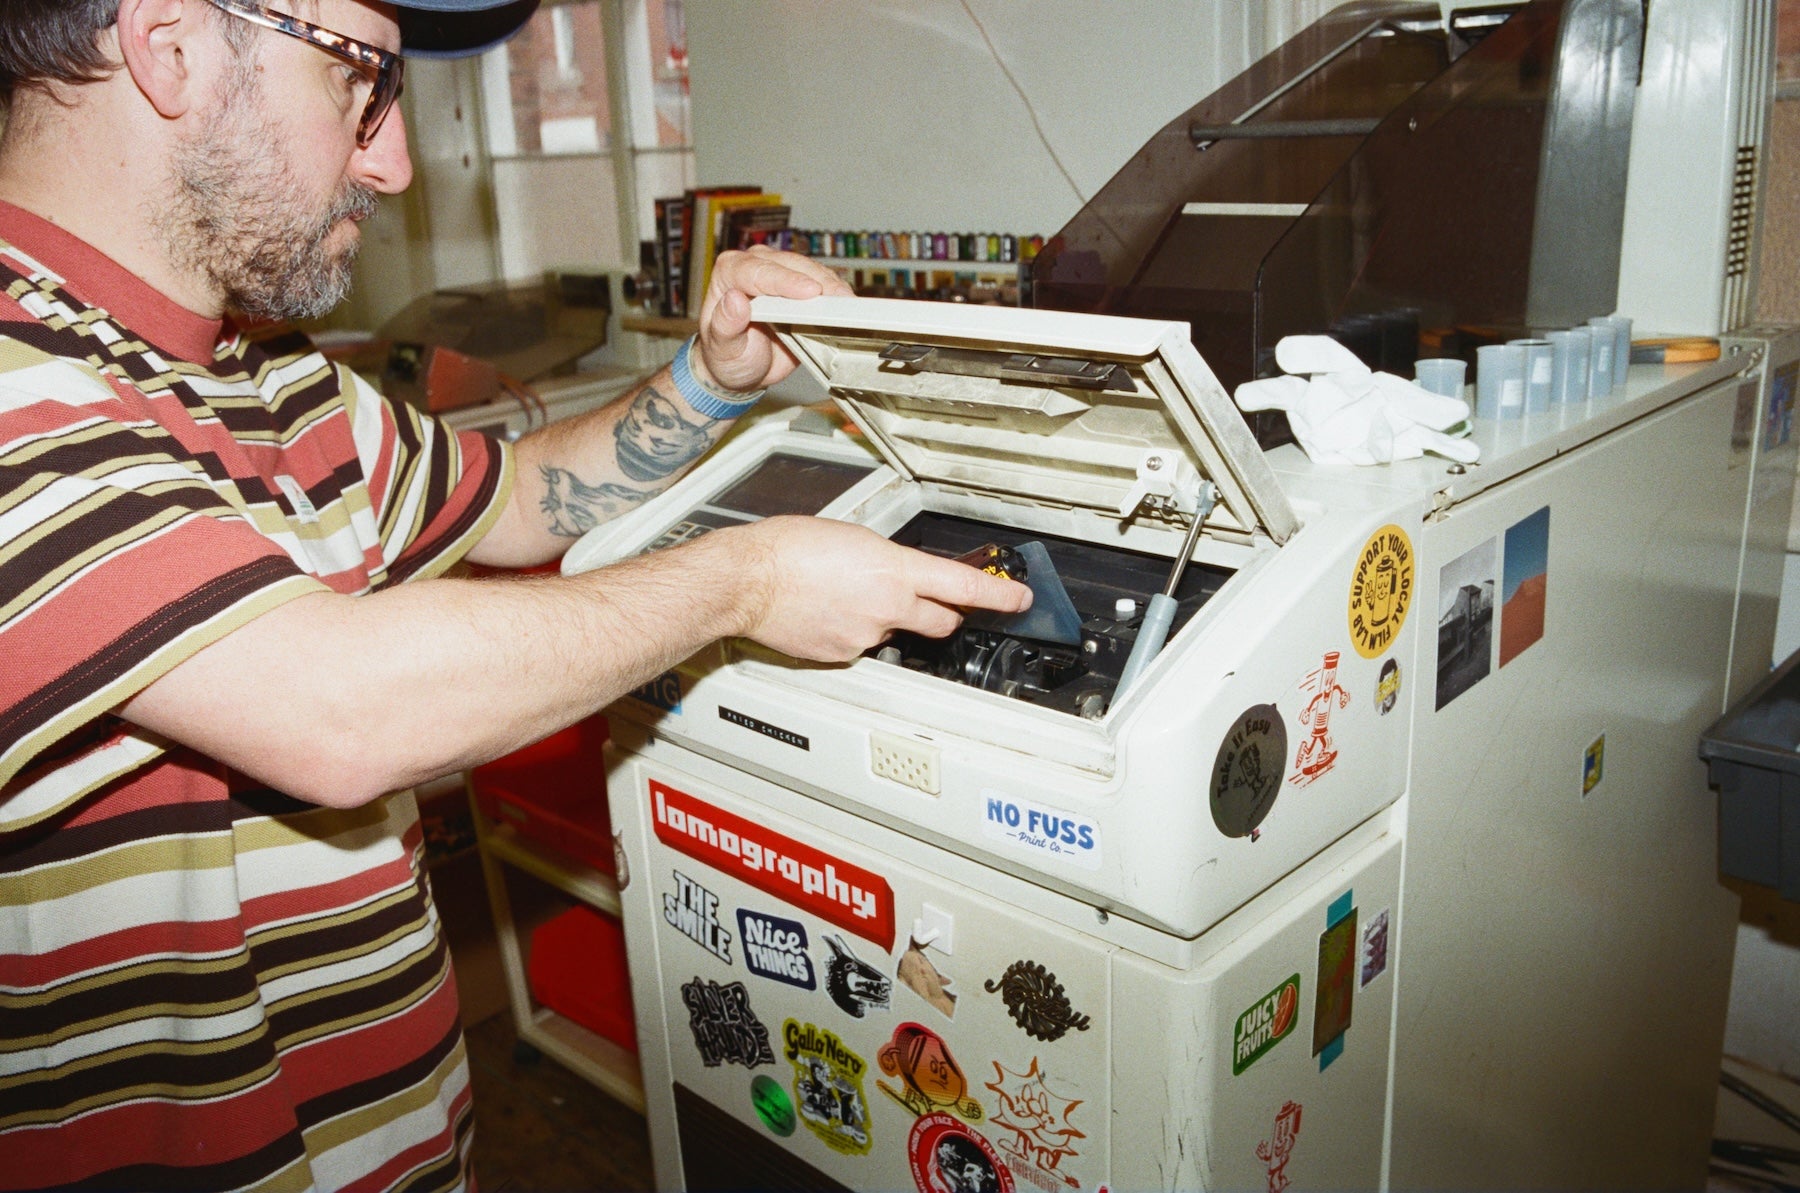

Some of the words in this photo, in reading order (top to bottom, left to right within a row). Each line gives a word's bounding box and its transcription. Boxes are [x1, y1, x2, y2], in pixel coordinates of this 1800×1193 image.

[1352, 534, 1385, 610] SUPPORT
[1388, 533, 1408, 566] YOUR
[1392, 566, 1410, 624] LOCAL
[1353, 614, 1369, 646] LAB
[1368, 624, 1391, 650] FILM
[761, 725, 803, 745] CHICKEN
[1217, 751, 1235, 798] Take
[1245, 718, 1271, 736] Easy
[986, 797, 1020, 828] NO
[1028, 809, 1094, 850] FUSS
[1018, 831, 1047, 849] Print
[655, 790, 877, 920] lomography
[673, 869, 719, 927] THE
[662, 892, 733, 966] SMILE
[744, 916, 805, 953] Nice
[747, 943, 809, 982] THINGS
[1236, 1018, 1273, 1064] FRUITS
[1237, 989, 1281, 1042] JUICY
[786, 1022, 825, 1060] Gallo
[824, 1033, 862, 1074] Nero
